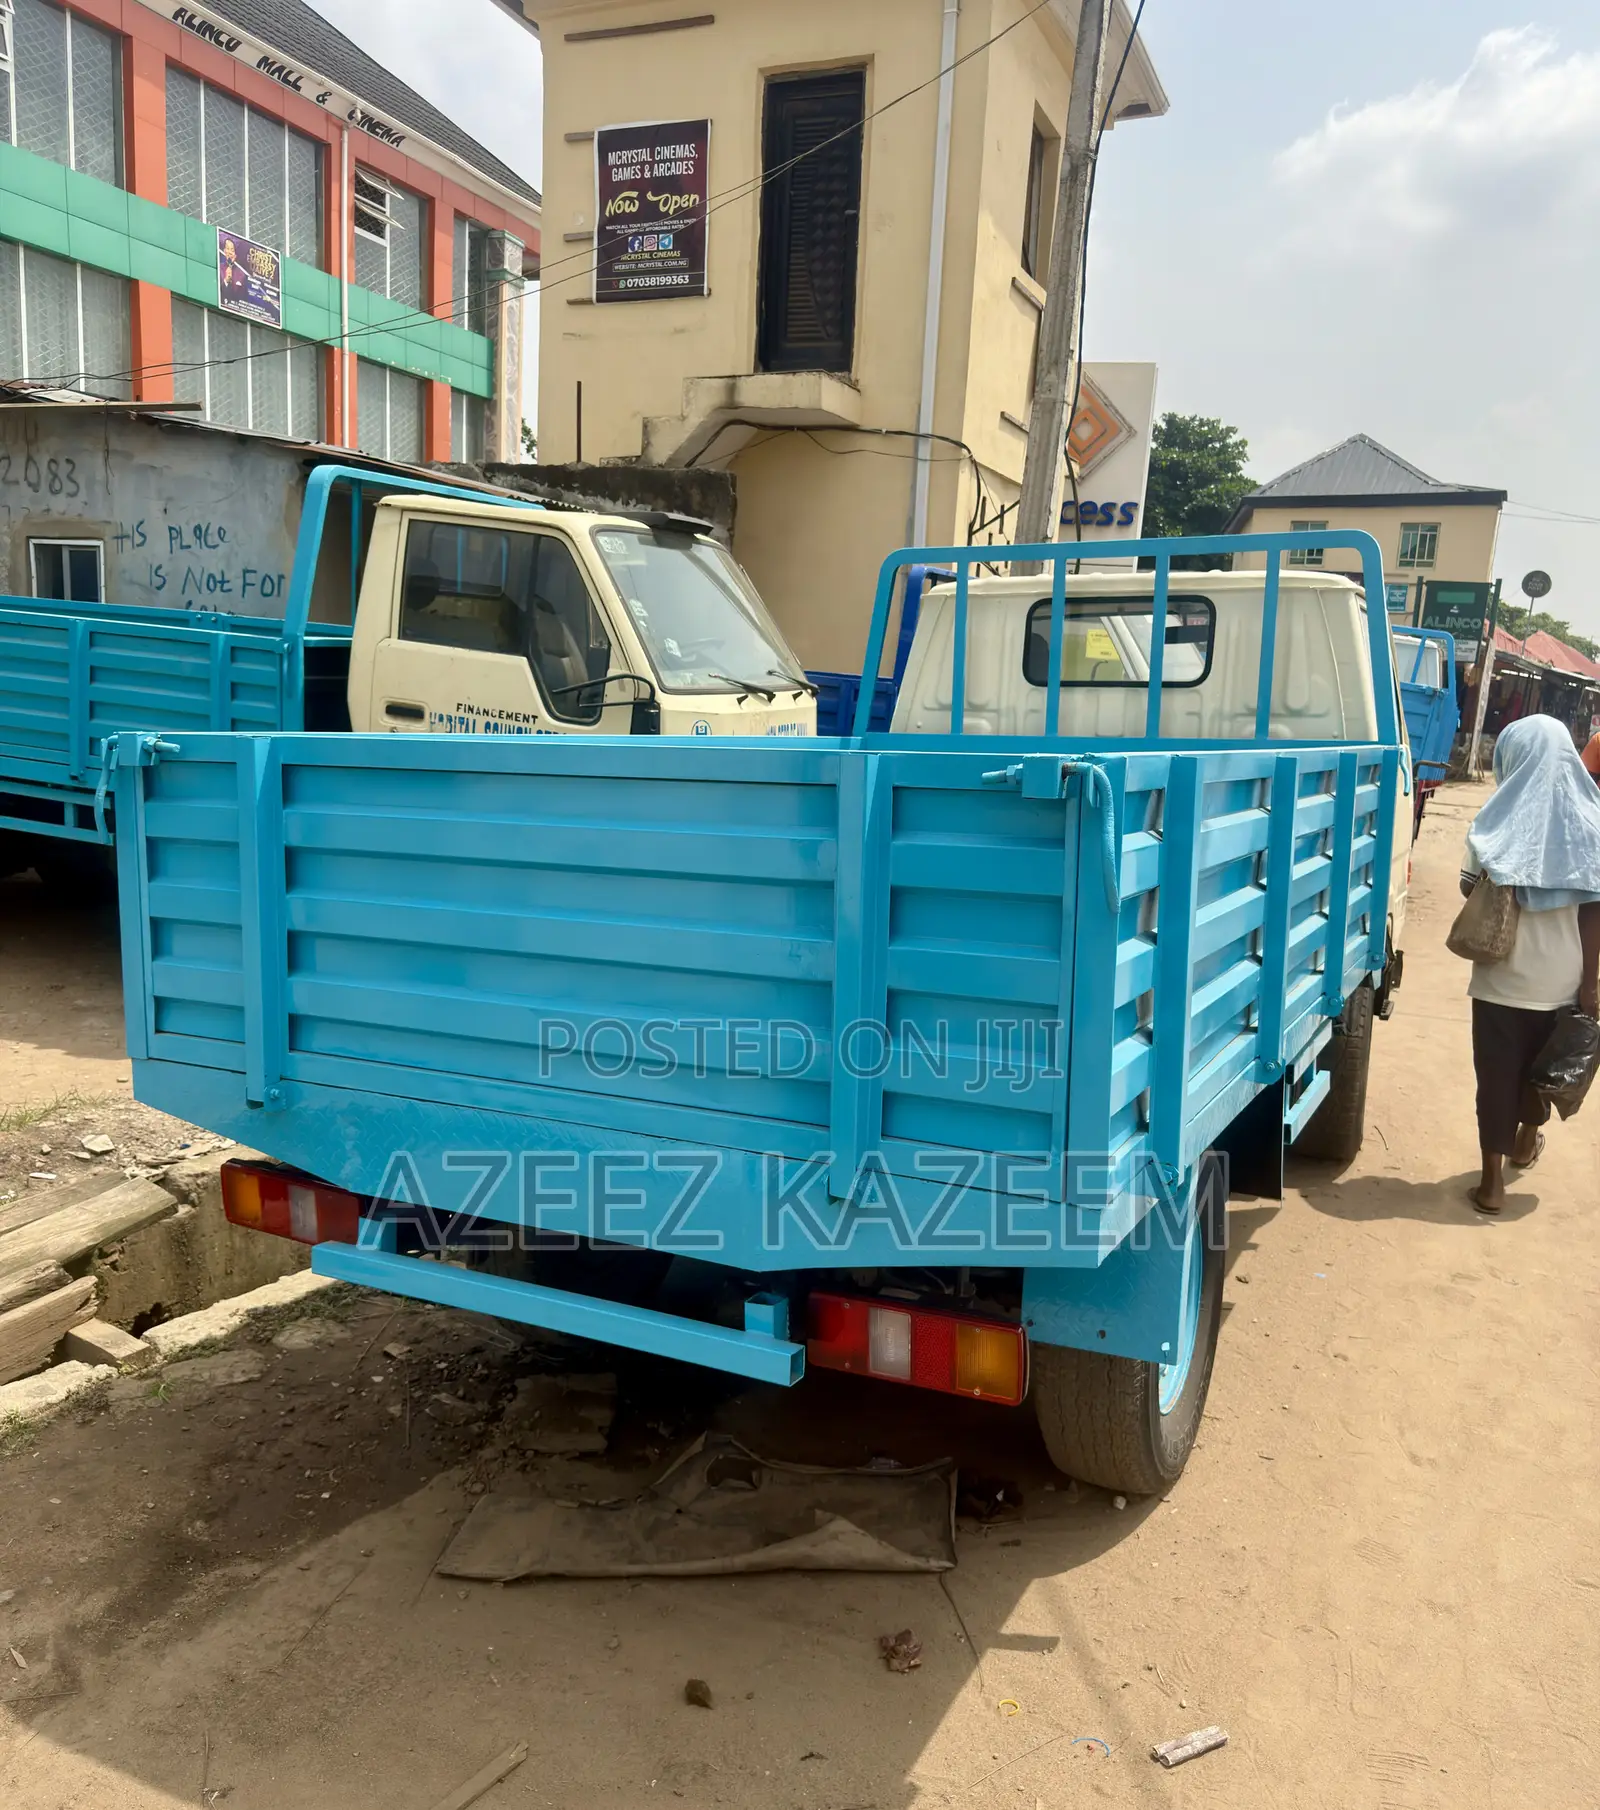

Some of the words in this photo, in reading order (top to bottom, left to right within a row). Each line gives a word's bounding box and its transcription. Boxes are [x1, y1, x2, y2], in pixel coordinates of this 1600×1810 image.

[255, 55, 305, 92] MALL
[315, 91, 333, 106] &
[607, 147, 653, 166] MCRYSTAL
[654, 143, 699, 161] CINEMAS,
[611, 165, 641, 182] GAMES
[643, 164, 652, 179] &
[652, 160, 695, 178] ARCADES
[604, 190, 640, 218] Now
[646, 190, 700, 216] Open
[652, 250, 681, 259] CINEMAS
[626, 275, 690, 288] 07038199363
[181, 566, 233, 595] Not
[1423, 615, 1482, 630] ALINCO
[455, 702, 539, 725] FINANCEMENT
